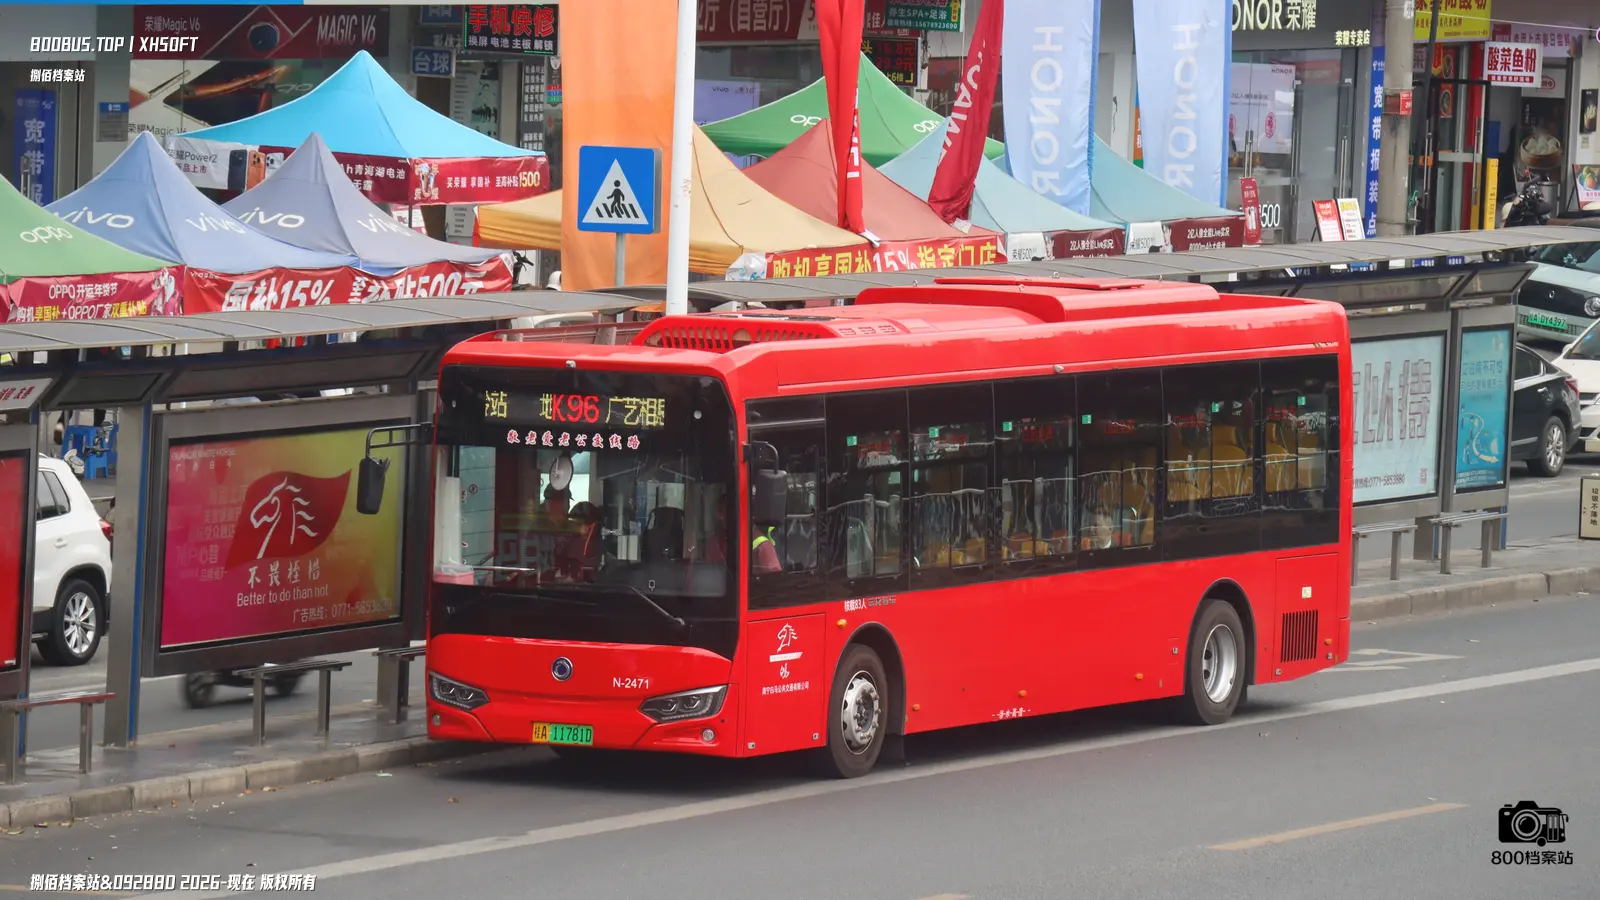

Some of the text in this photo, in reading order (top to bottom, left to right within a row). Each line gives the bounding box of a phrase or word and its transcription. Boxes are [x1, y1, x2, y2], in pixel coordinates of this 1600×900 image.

[144, 15, 201, 34] 荣耀Magic V6
[468, 5, 556, 36] 手机快修
[1232, 0, 1317, 30] ONOR 荣耀
[316, 14, 377, 45] MAGIC V6
[1335, 29, 1371, 46] 荣耀专卖店
[468, 35, 488, 46] 换屏
[490, 37, 509, 48] 电池
[512, 39, 532, 49] 主板
[533, 39, 554, 51] 解锁
[413, 52, 450, 74] 台球
[1487, 46, 1537, 72] 酸菜鱼粉
[912, 119, 940, 133] opp
[20, 225, 73, 244] oppo
[185, 212, 247, 235] vivo
[48, 282, 119, 300] OPPO开运年货节
[222, 277, 335, 312] 国补15%
[552, 394, 600, 423] K96
[507, 429, 641, 450] 敬老爱老公交线路
[247, 558, 321, 589] 不畏桎梏
[237, 585, 329, 607] Better to do than not
[612, 677, 650, 690] N-2471
